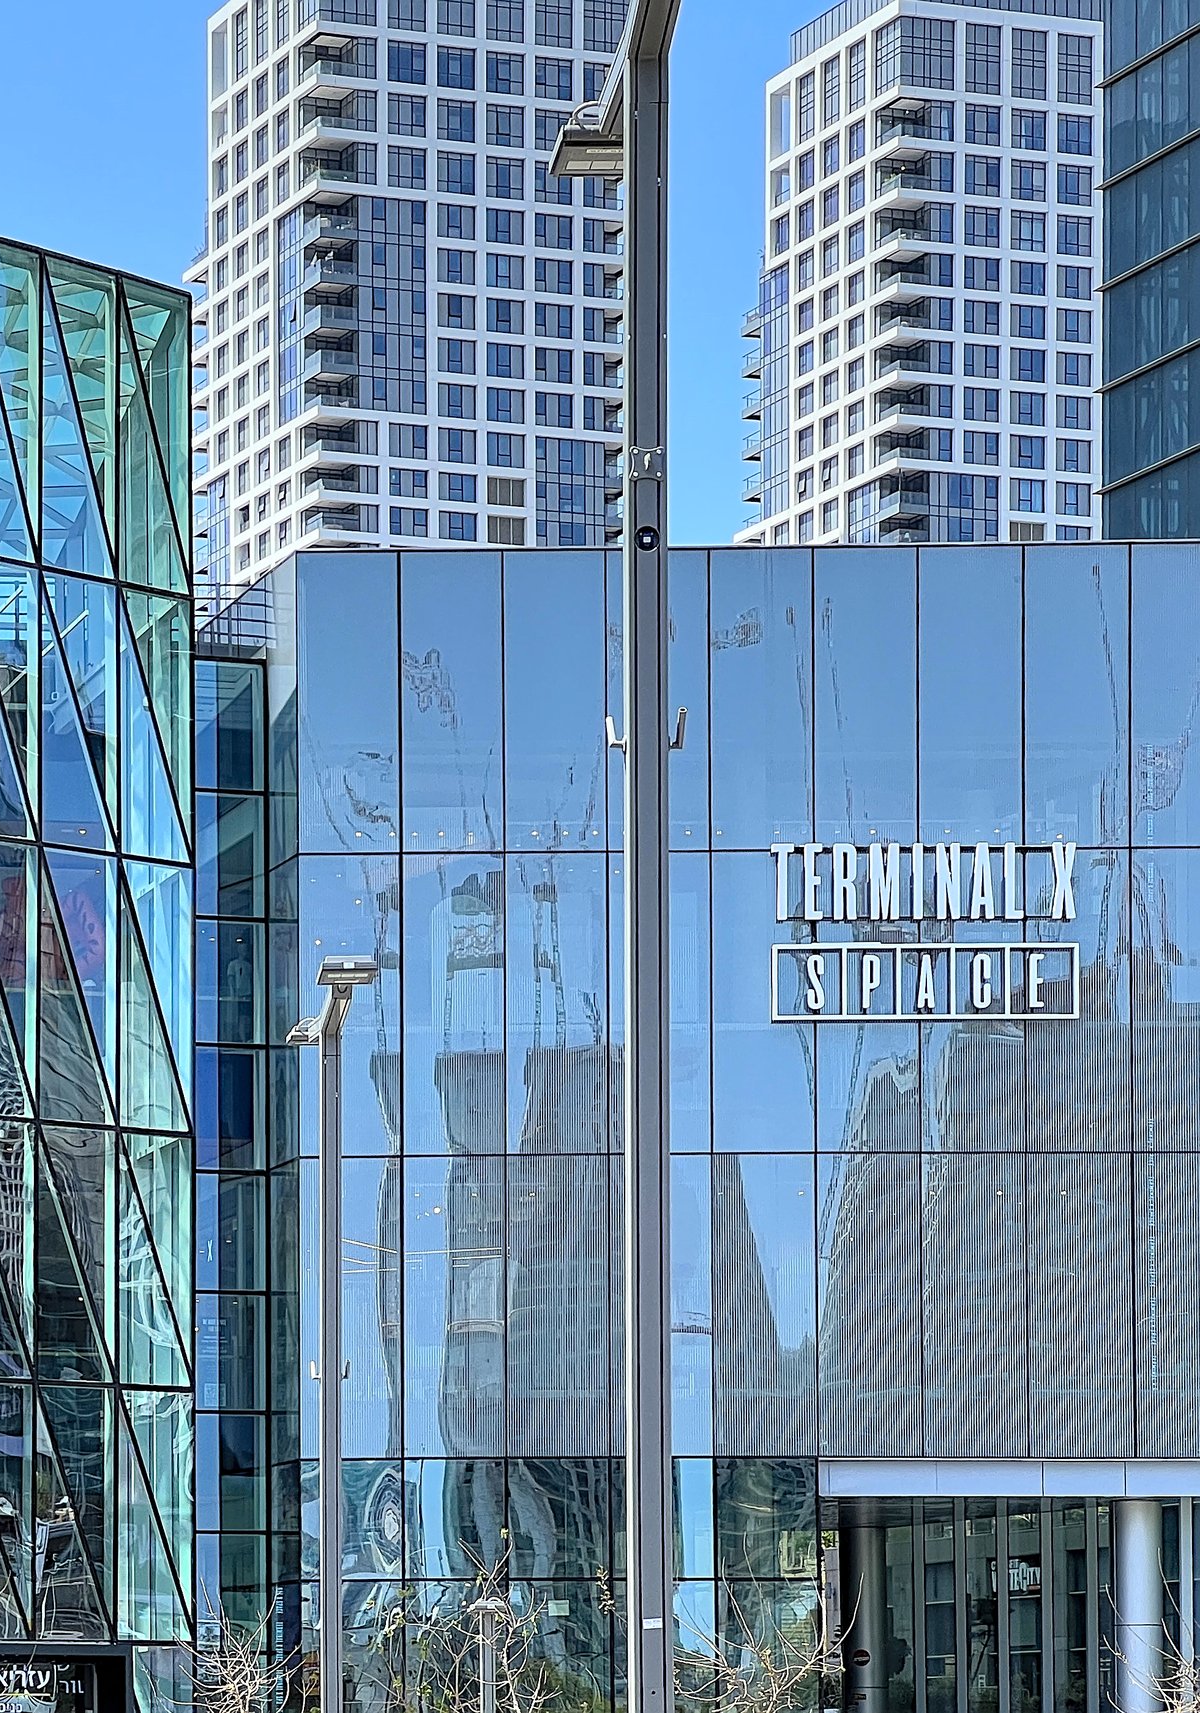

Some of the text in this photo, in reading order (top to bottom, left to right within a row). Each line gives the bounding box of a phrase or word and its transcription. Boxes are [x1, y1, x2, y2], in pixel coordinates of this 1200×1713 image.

[770, 841, 1077, 920] TERMINAL X
[806, 953, 1046, 1010] SPACE
